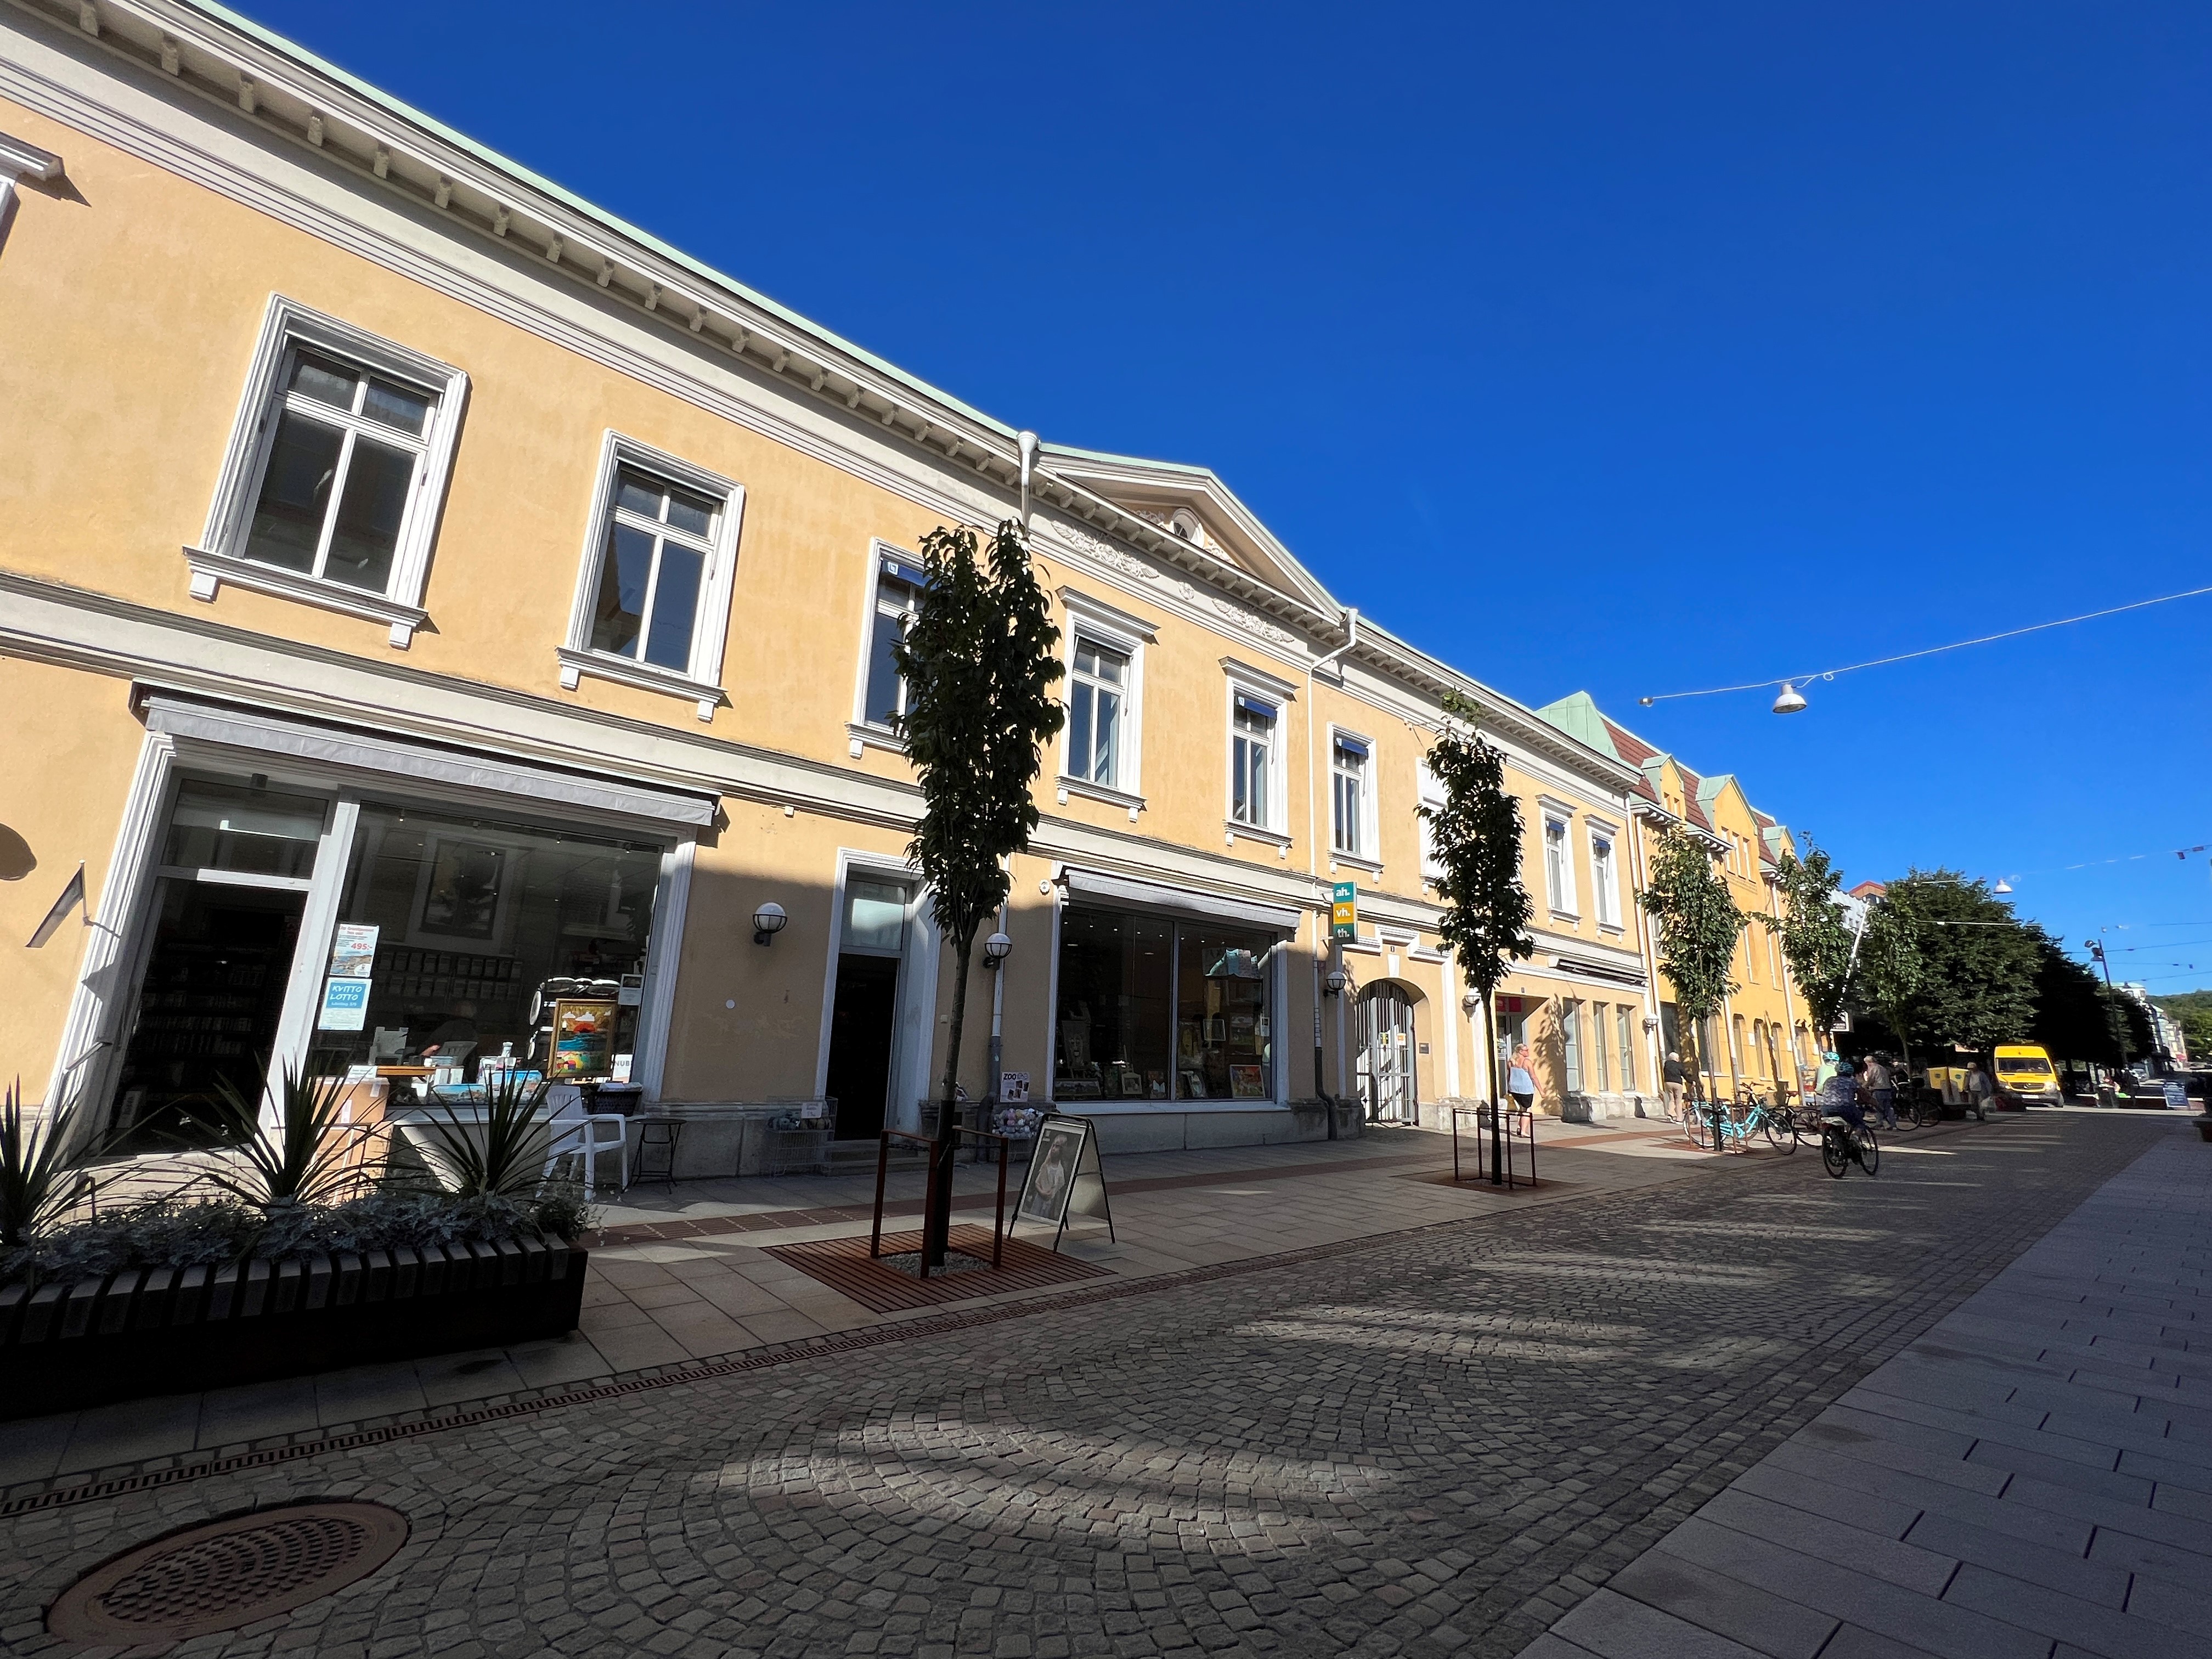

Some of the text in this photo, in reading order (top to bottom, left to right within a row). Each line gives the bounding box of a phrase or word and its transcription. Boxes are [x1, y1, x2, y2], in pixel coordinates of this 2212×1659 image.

[1336, 887, 1350, 897] ah.
[1336, 907, 1351, 917] vh.
[1337, 928, 1350, 938] th.
